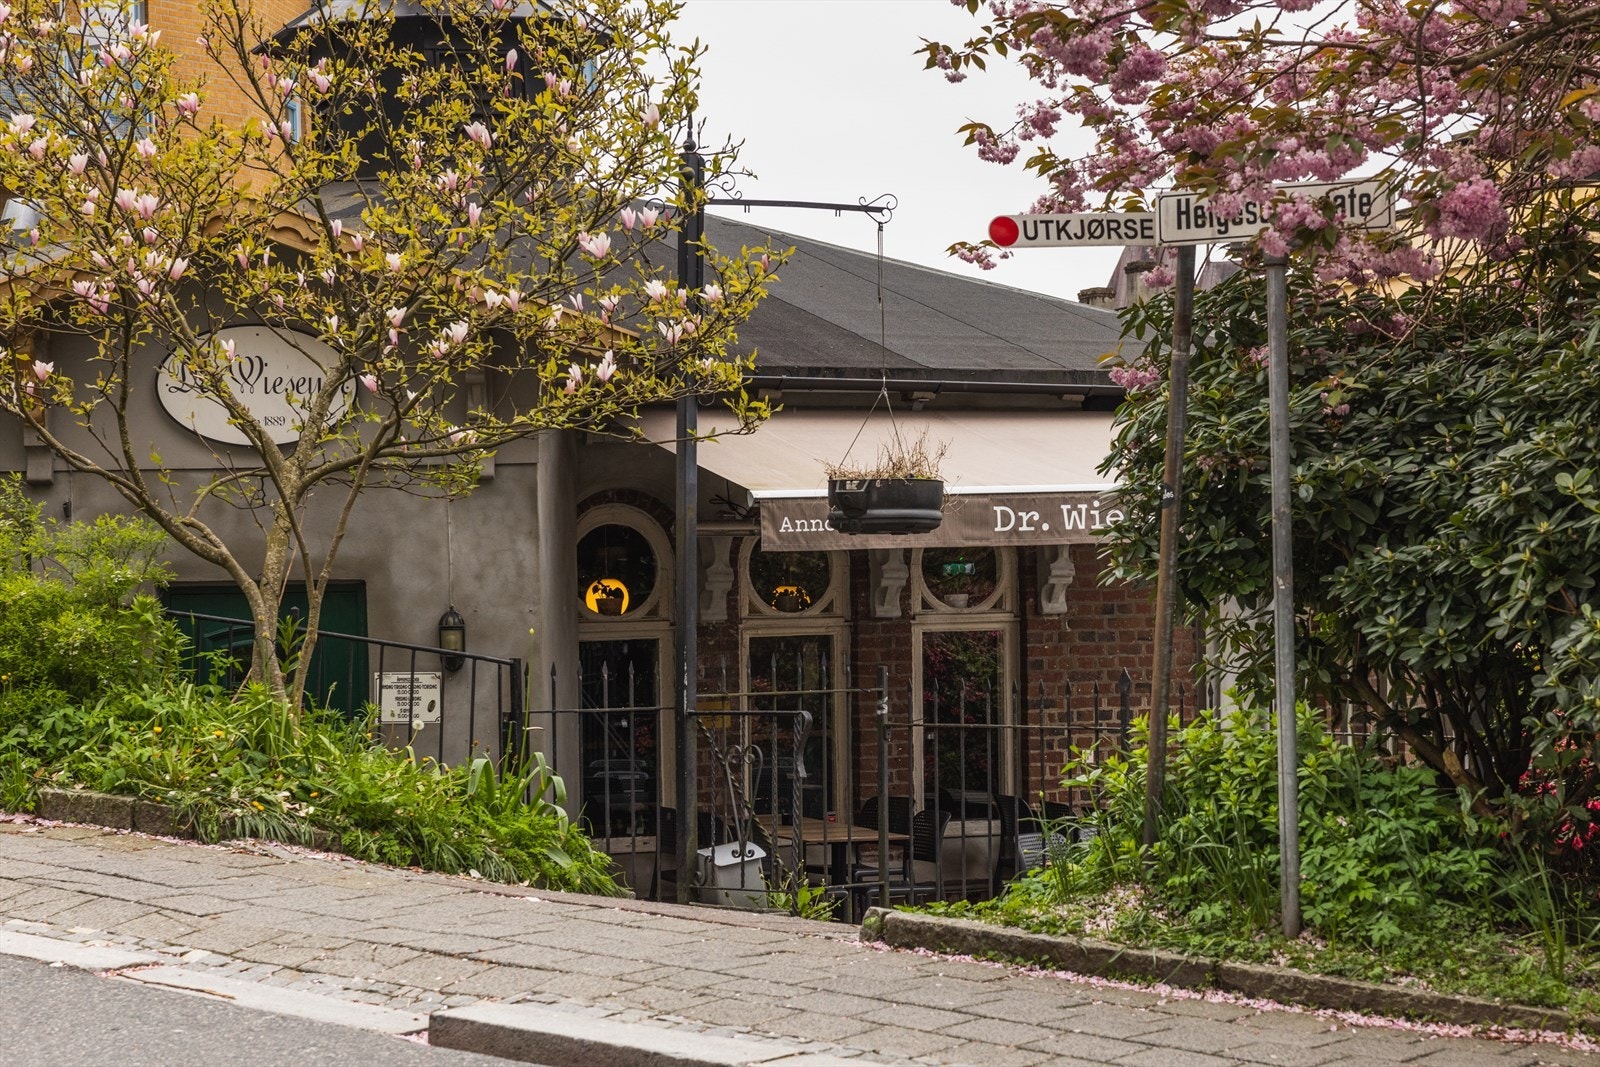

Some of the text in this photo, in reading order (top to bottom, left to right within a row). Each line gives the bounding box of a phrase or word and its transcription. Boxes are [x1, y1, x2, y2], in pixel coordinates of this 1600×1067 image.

[1333, 187, 1373, 218] ate
[1022, 218, 1155, 241] UTKJØRSE
[264, 415, 286, 427] 1889
[993, 504, 1050, 532] Dr.
